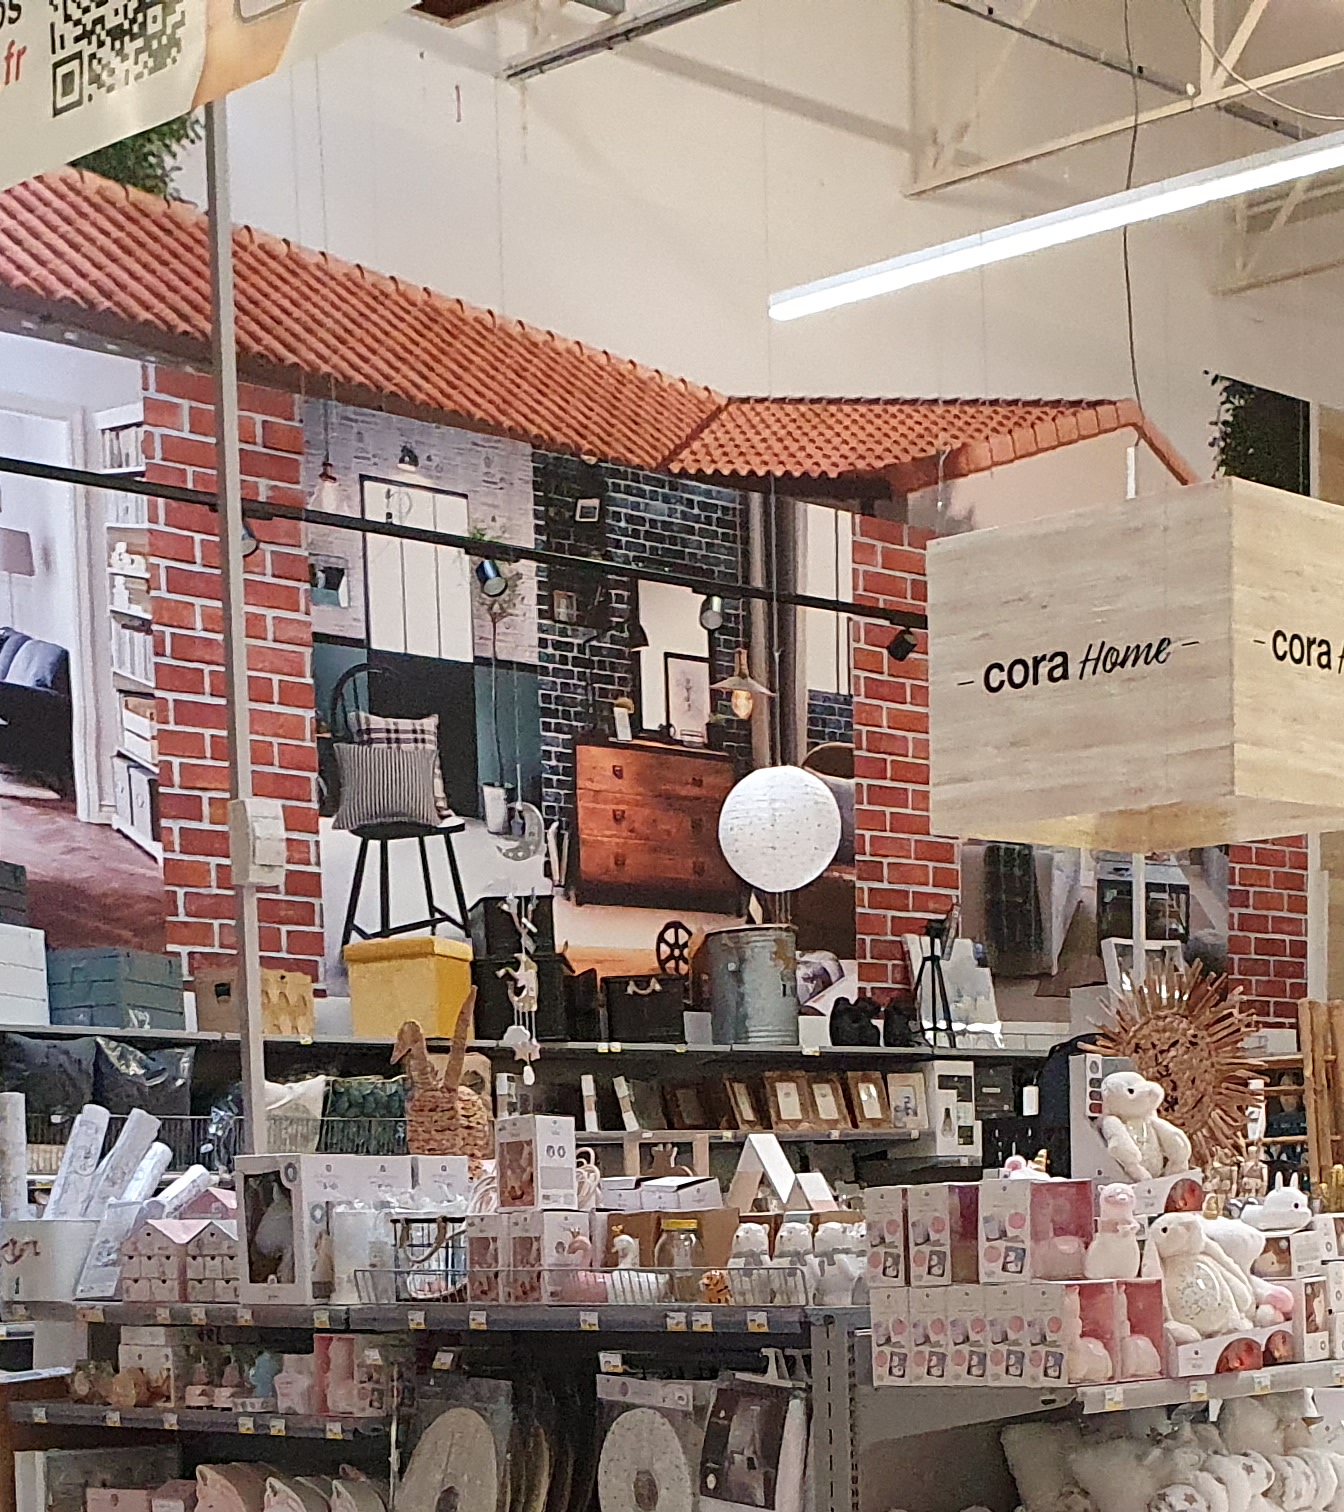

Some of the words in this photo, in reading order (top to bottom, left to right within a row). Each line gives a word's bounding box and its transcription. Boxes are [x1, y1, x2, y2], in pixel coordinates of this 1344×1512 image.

[984, 650, 1070, 693] cora
[1078, 636, 1172, 680] Home
[1273, 630, 1332, 670] cora
